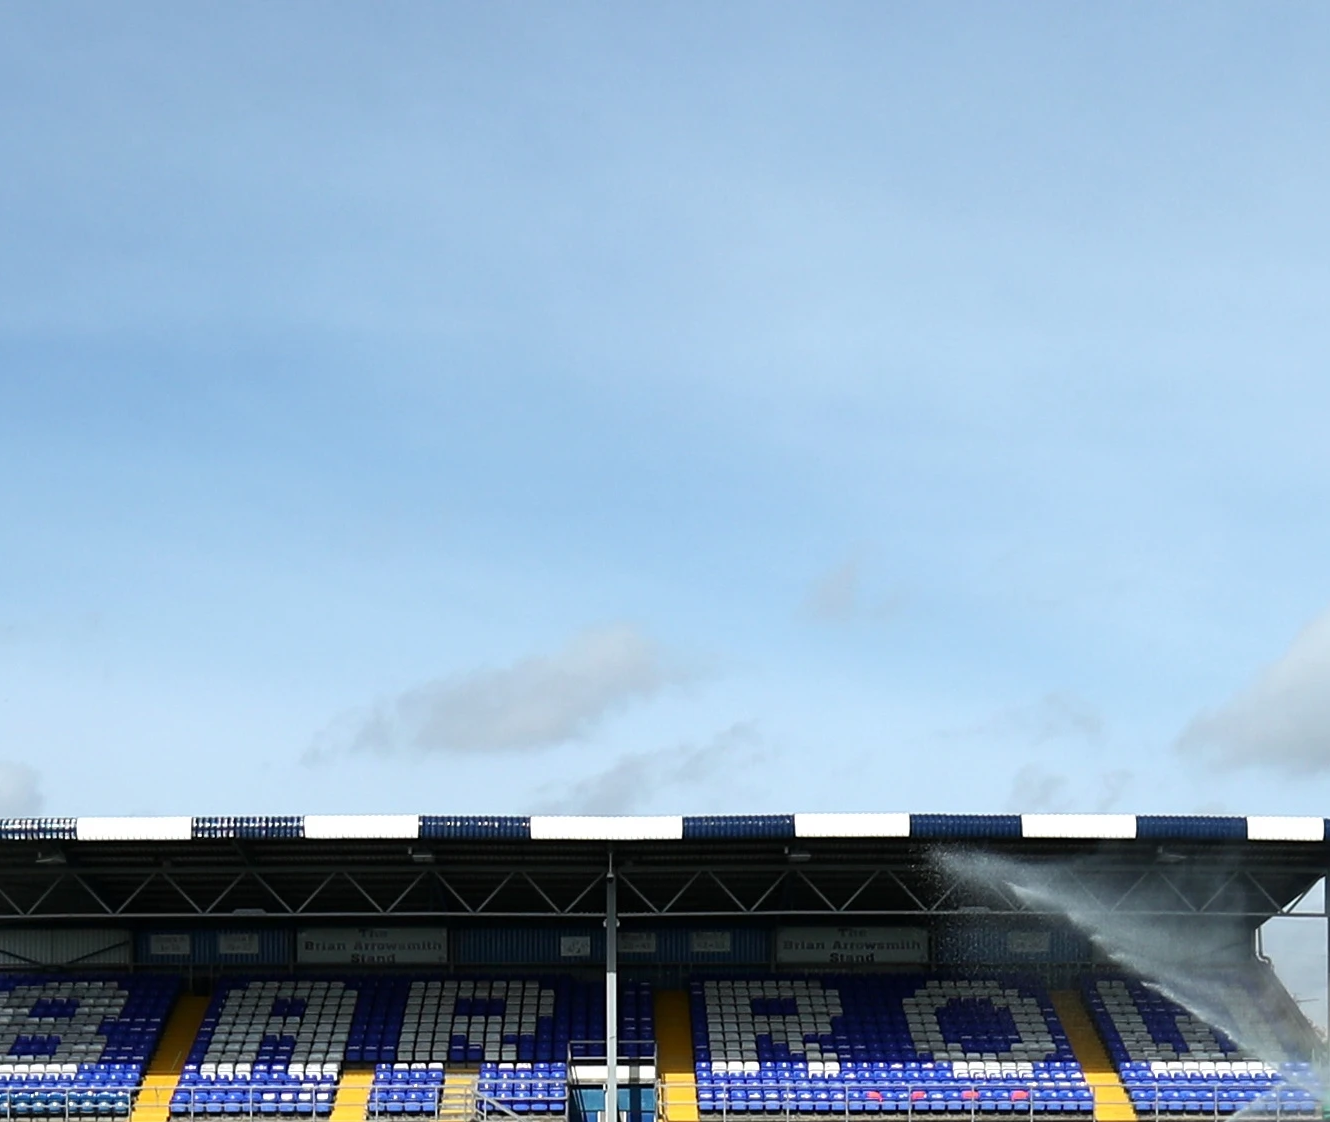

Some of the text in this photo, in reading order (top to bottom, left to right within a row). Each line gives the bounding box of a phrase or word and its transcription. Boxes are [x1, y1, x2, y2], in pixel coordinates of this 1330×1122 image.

[837, 928, 868, 938] The
[304, 940, 442, 951] Brian Arrowsmith
[782, 940, 921, 951] Brian Arrowsmith
[350, 953, 397, 964] Stand
[829, 952, 875, 964] Stand
